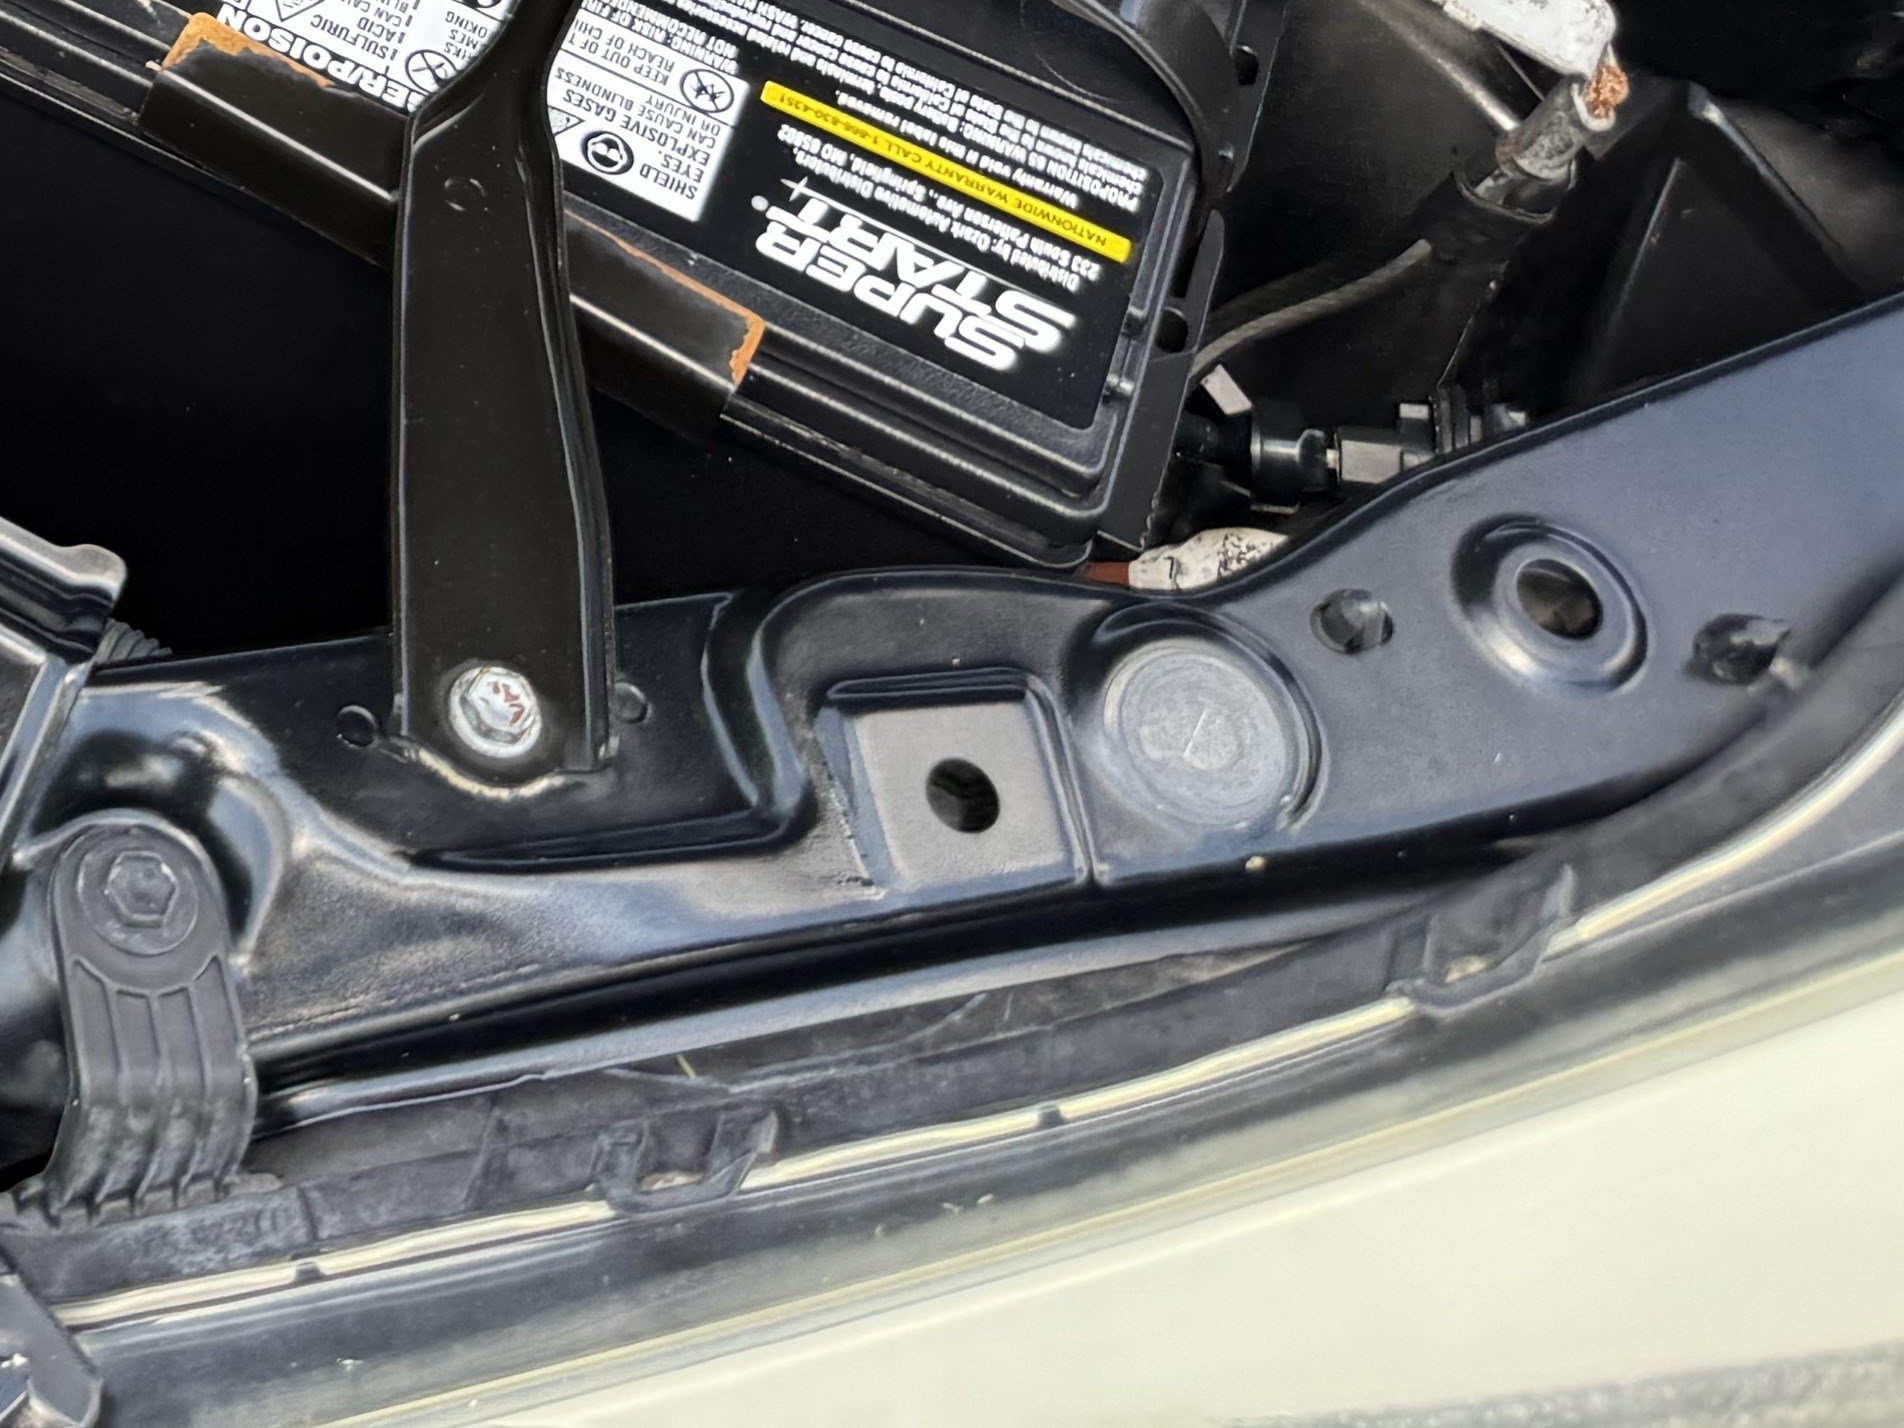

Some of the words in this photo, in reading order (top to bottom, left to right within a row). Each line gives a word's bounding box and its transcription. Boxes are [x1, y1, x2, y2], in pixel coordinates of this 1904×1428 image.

[355, 14, 398, 43] ACID
[372, 5, 404, 28] CAN
[307, 11, 392, 60] SULFURIC
[577, 35, 600, 55] OF
[605, 31, 626, 50] OF
[600, 46, 632, 69] OUT
[626, 40, 676, 72] REACH
[631, 60, 670, 86] KEEP
[552, 64, 636, 112] BLINDNESS
[560, 86, 618, 123] GASES
[634, 102, 685, 135] CAUSE
[642, 91, 698, 126] INJURY
[617, 112, 713, 166] EXPLOSIVE
[685, 126, 718, 149] CAN
[699, 117, 722, 136] OR
[652, 148, 705, 183] EYES.
[884, 139, 923, 165] CALL
[636, 161, 699, 200] SHIELD
[923, 157, 1010, 203] WARRANTY
[1011, 196, 1108, 247] NATIONWIDE
[758, 181, 1081, 363] START
[747, 214, 1029, 377] SUPER
